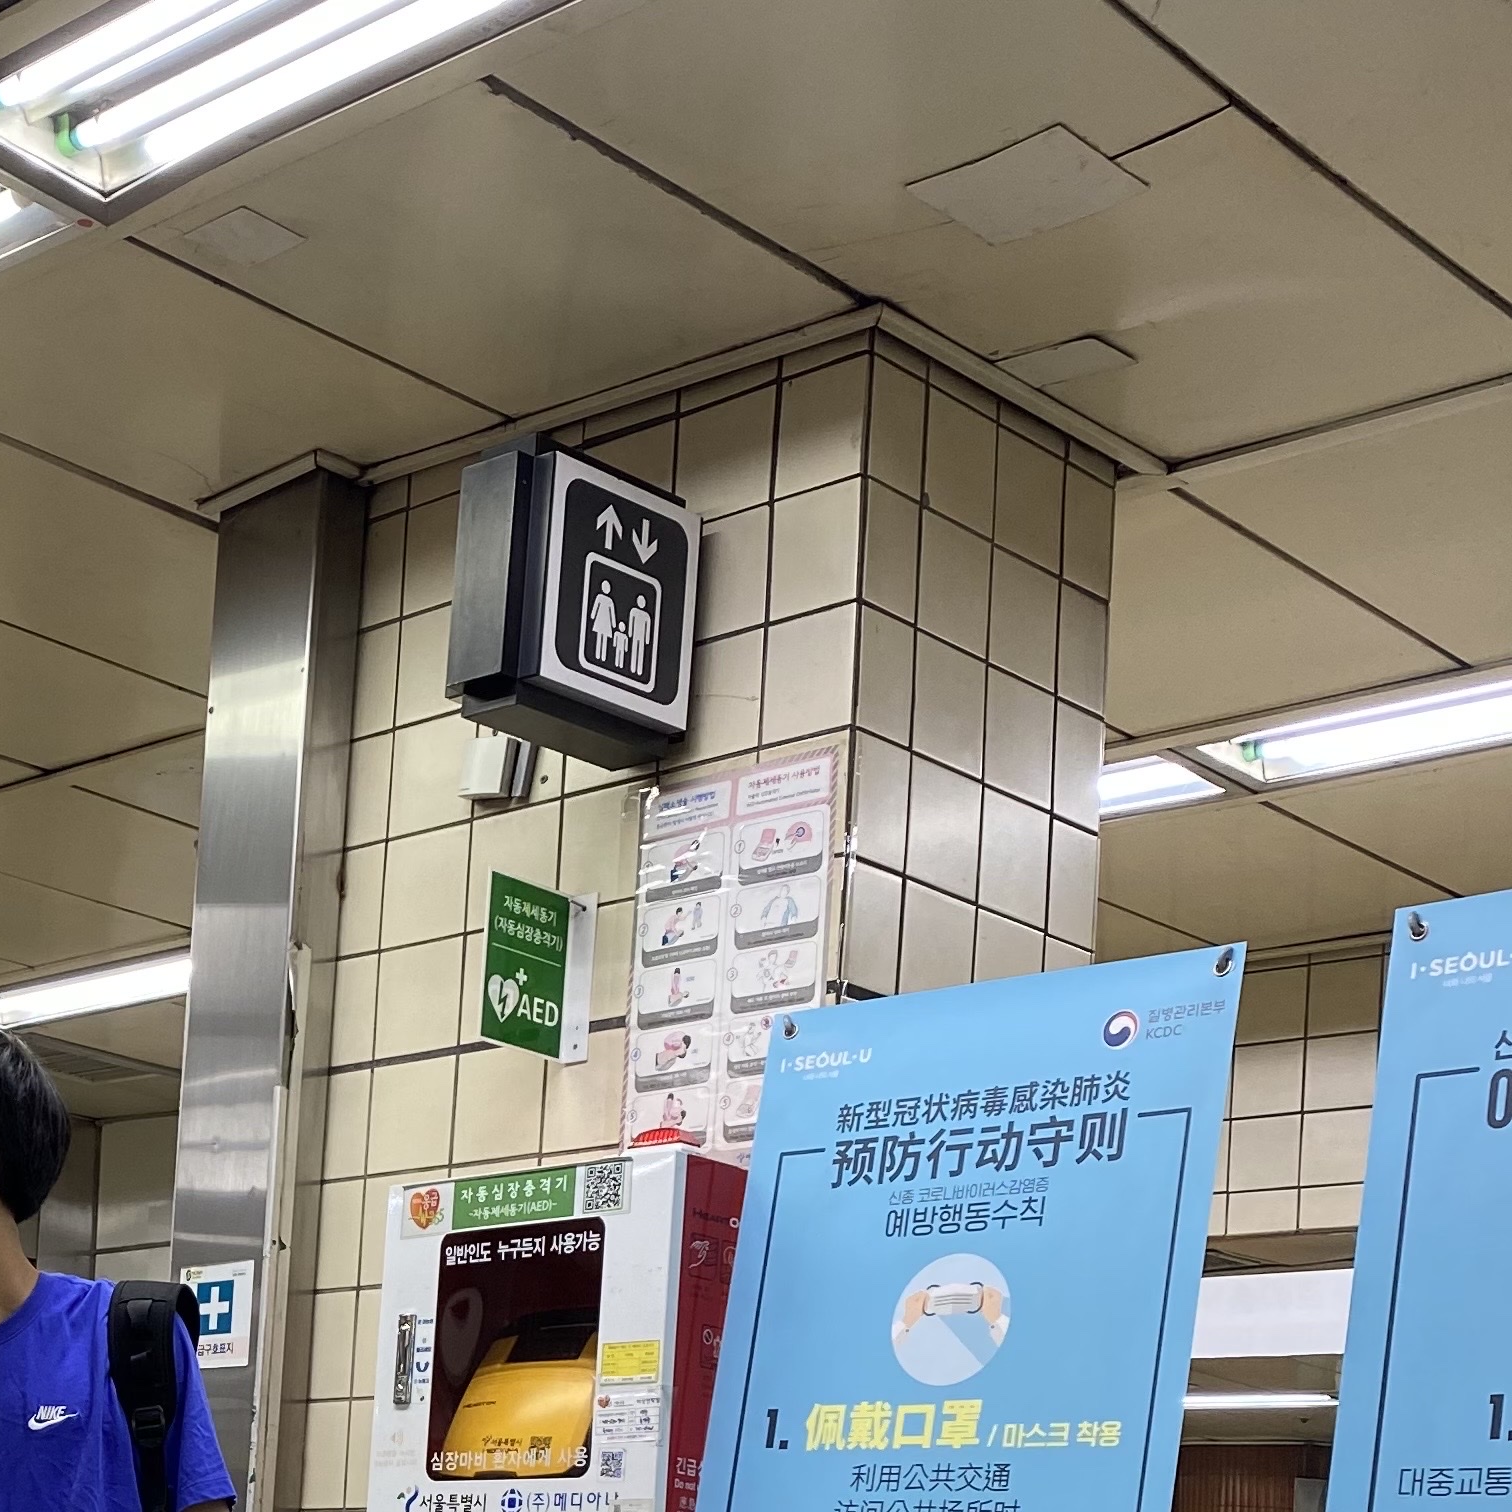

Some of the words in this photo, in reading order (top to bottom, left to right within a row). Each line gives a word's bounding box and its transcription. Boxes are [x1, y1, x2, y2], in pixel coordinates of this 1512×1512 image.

[504, 895, 557, 927] 자동제세동기
[494, 915, 563, 952] (자동심장충격기)
[516, 993, 559, 1027] AED
[1148, 1000, 1226, 1024] 질병관리본부
[1146, 1024, 1182, 1040] KCDC
[836, 1070, 1131, 1133] 新型冠状病毒感染肺炎
[830, 1107, 1128, 1189] 预防行动守则
[889, 1189, 914, 1206] 신종
[917, 1176, 1050, 1203] 코로나바이러스감염증
[885, 1196, 1047, 1238] 예방행동수칙
[445, 1242, 491, 1266] 일반인도
[497, 1238, 545, 1261] 누구든지
[550, 1230, 601, 1256] 사용가능
[198, 1342, 233, 1357] 급구호표지
[36, 1405, 67, 1420] NIKE
[765, 1408, 789, 1450] 1.
[806, 1398, 983, 1451] 佩戴口罩
[1002, 1422, 1070, 1449] 마스크
[1076, 1420, 1122, 1448] 착용
[430, 1452, 487, 1471] 심장마비
[492, 1449, 551, 1469] 환자에게
[558, 1446, 588, 1467] 사용
[849, 1463, 1011, 1493] 利用公共交通
[1398, 1467, 1512, 1497] 대중교통
